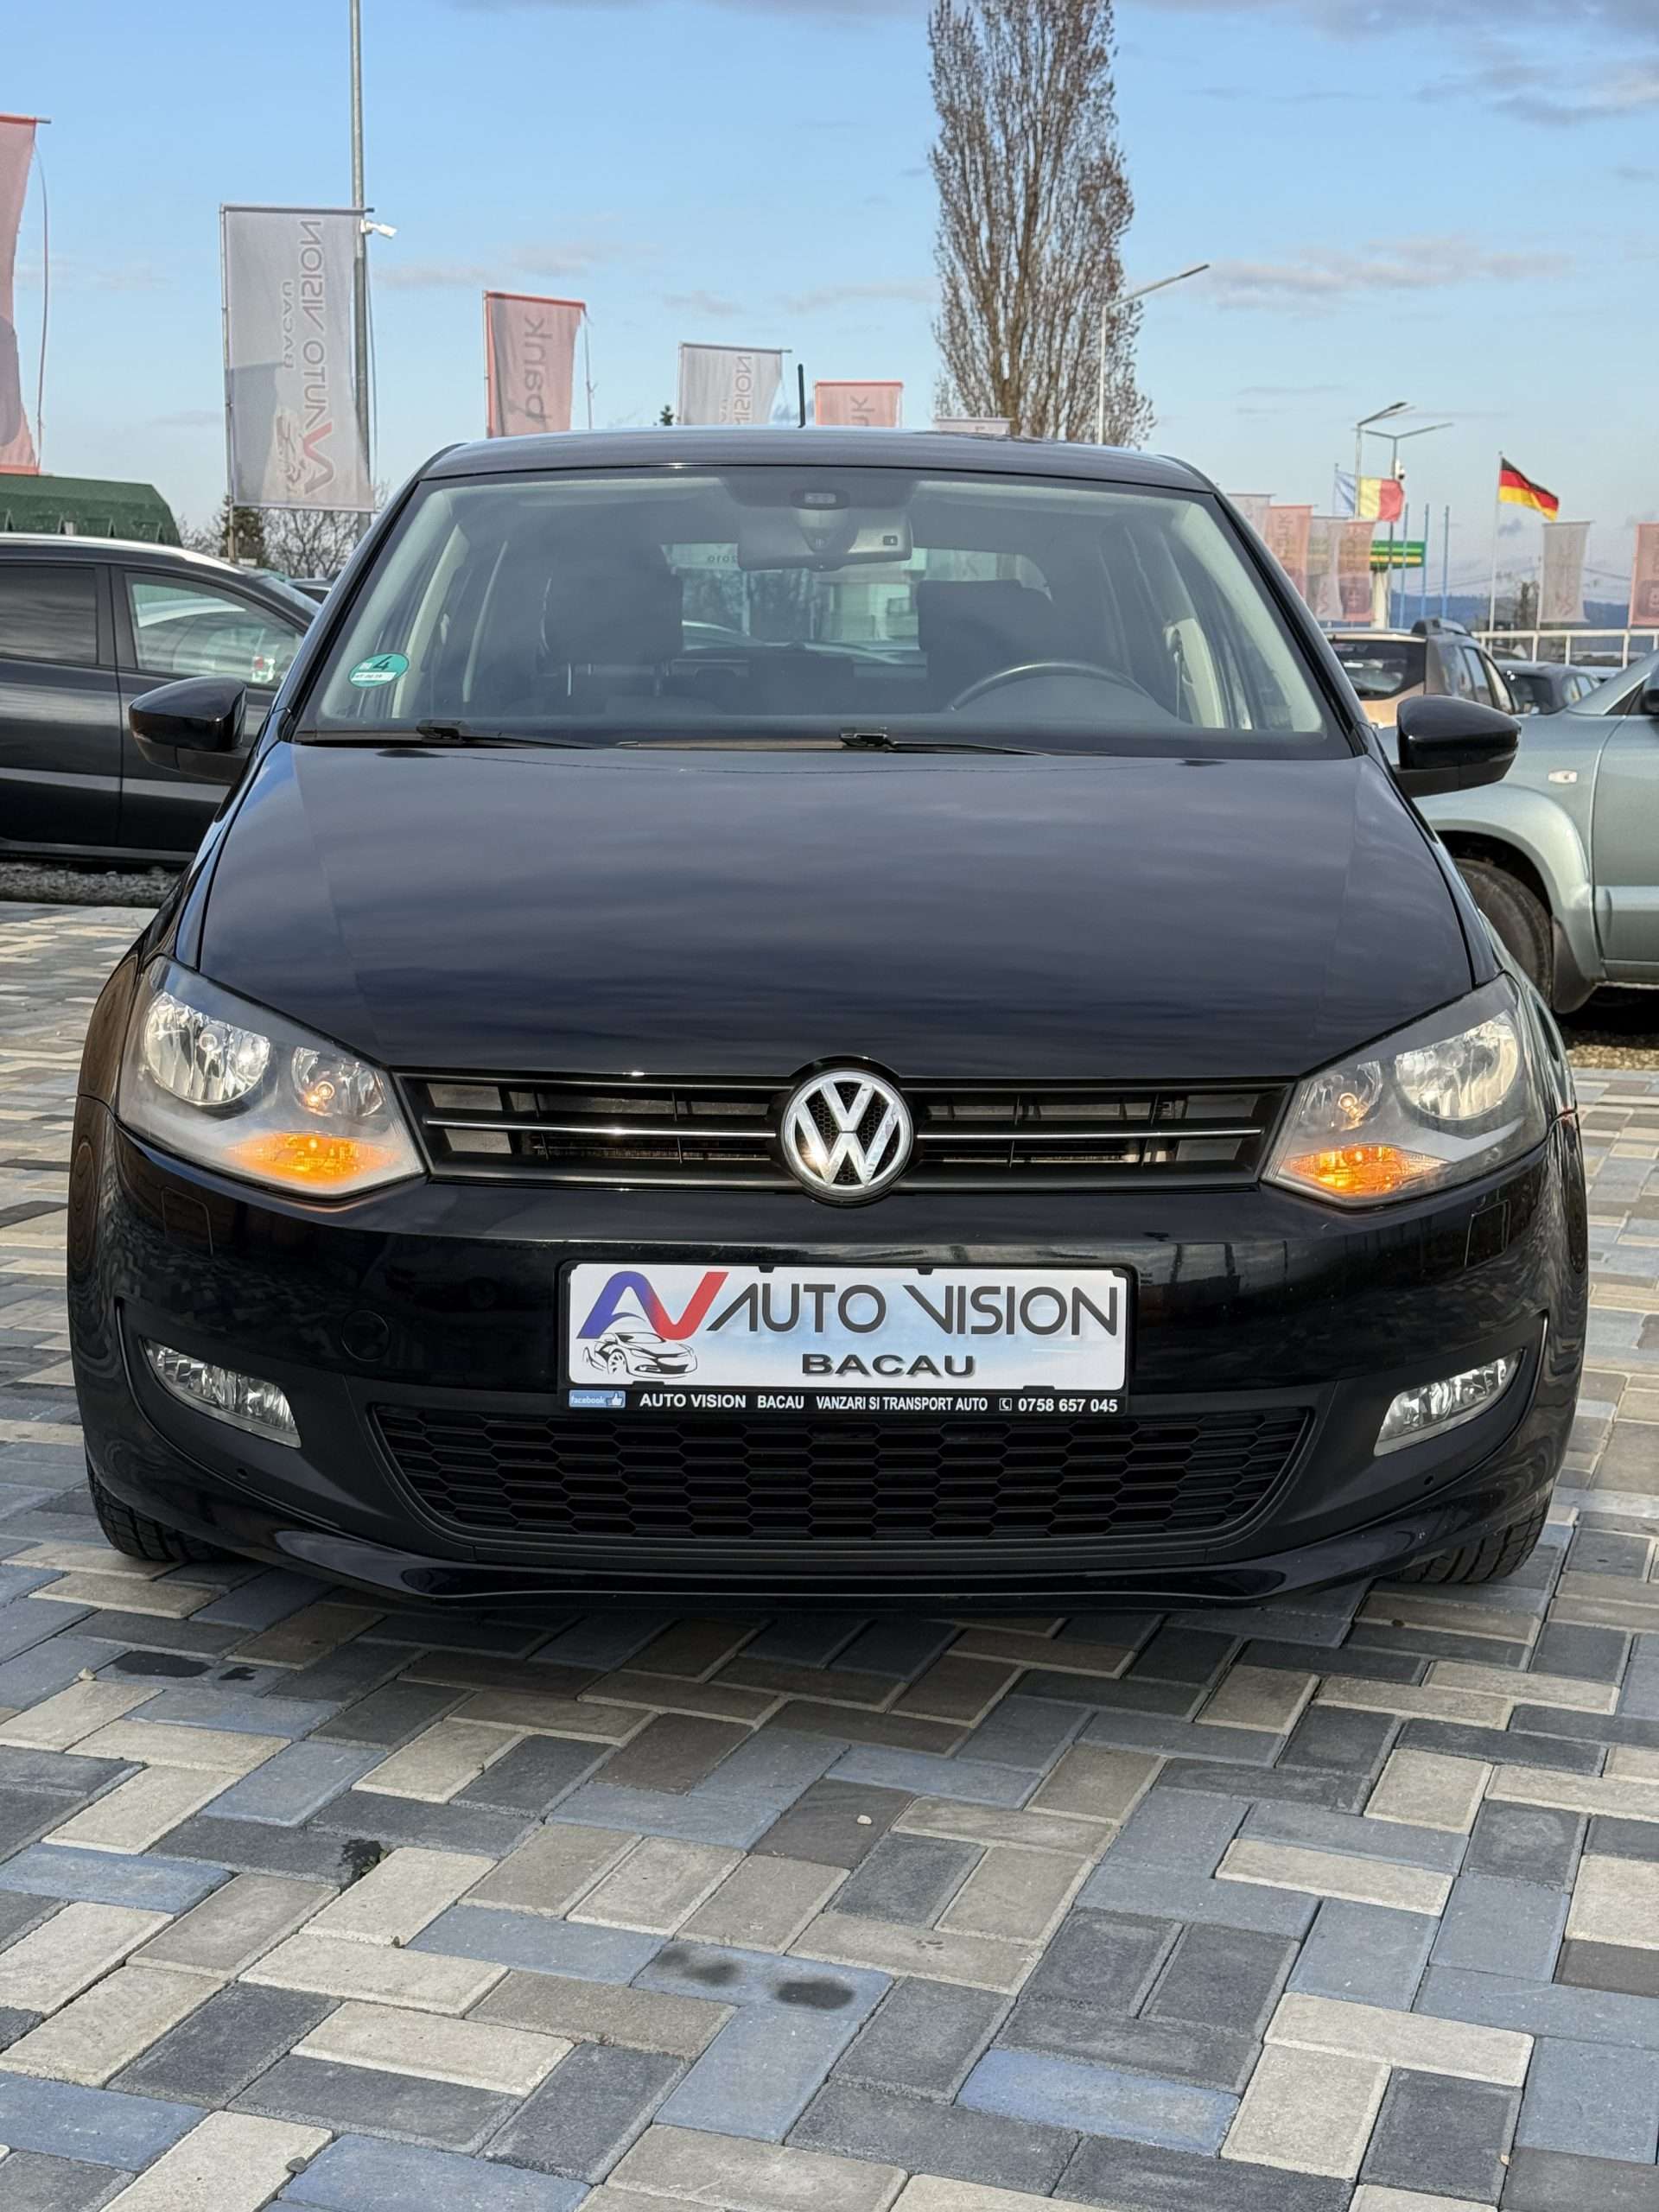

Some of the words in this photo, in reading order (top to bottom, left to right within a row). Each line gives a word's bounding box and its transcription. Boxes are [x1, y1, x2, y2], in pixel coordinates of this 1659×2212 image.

[705, 1282, 887, 1334] AUTO
[902, 1284, 1118, 1337] VISION
[802, 1353, 976, 1377] BACAU
[570, 1395, 607, 1405] facebook
[639, 1393, 687, 1408] AUTO
[690, 1394, 747, 1409] VISION
[757, 1395, 804, 1409] BACAU
[816, 1395, 866, 1410] VANZARI
[868, 1396, 880, 1410] SI
[882, 1396, 954, 1411] TRANSPORT
[955, 1397, 988, 1412] AUTO
[1018, 1397, 1054, 1413] 0758
[1058, 1398, 1087, 1413] 657
[1090, 1398, 1119, 1414] 045
